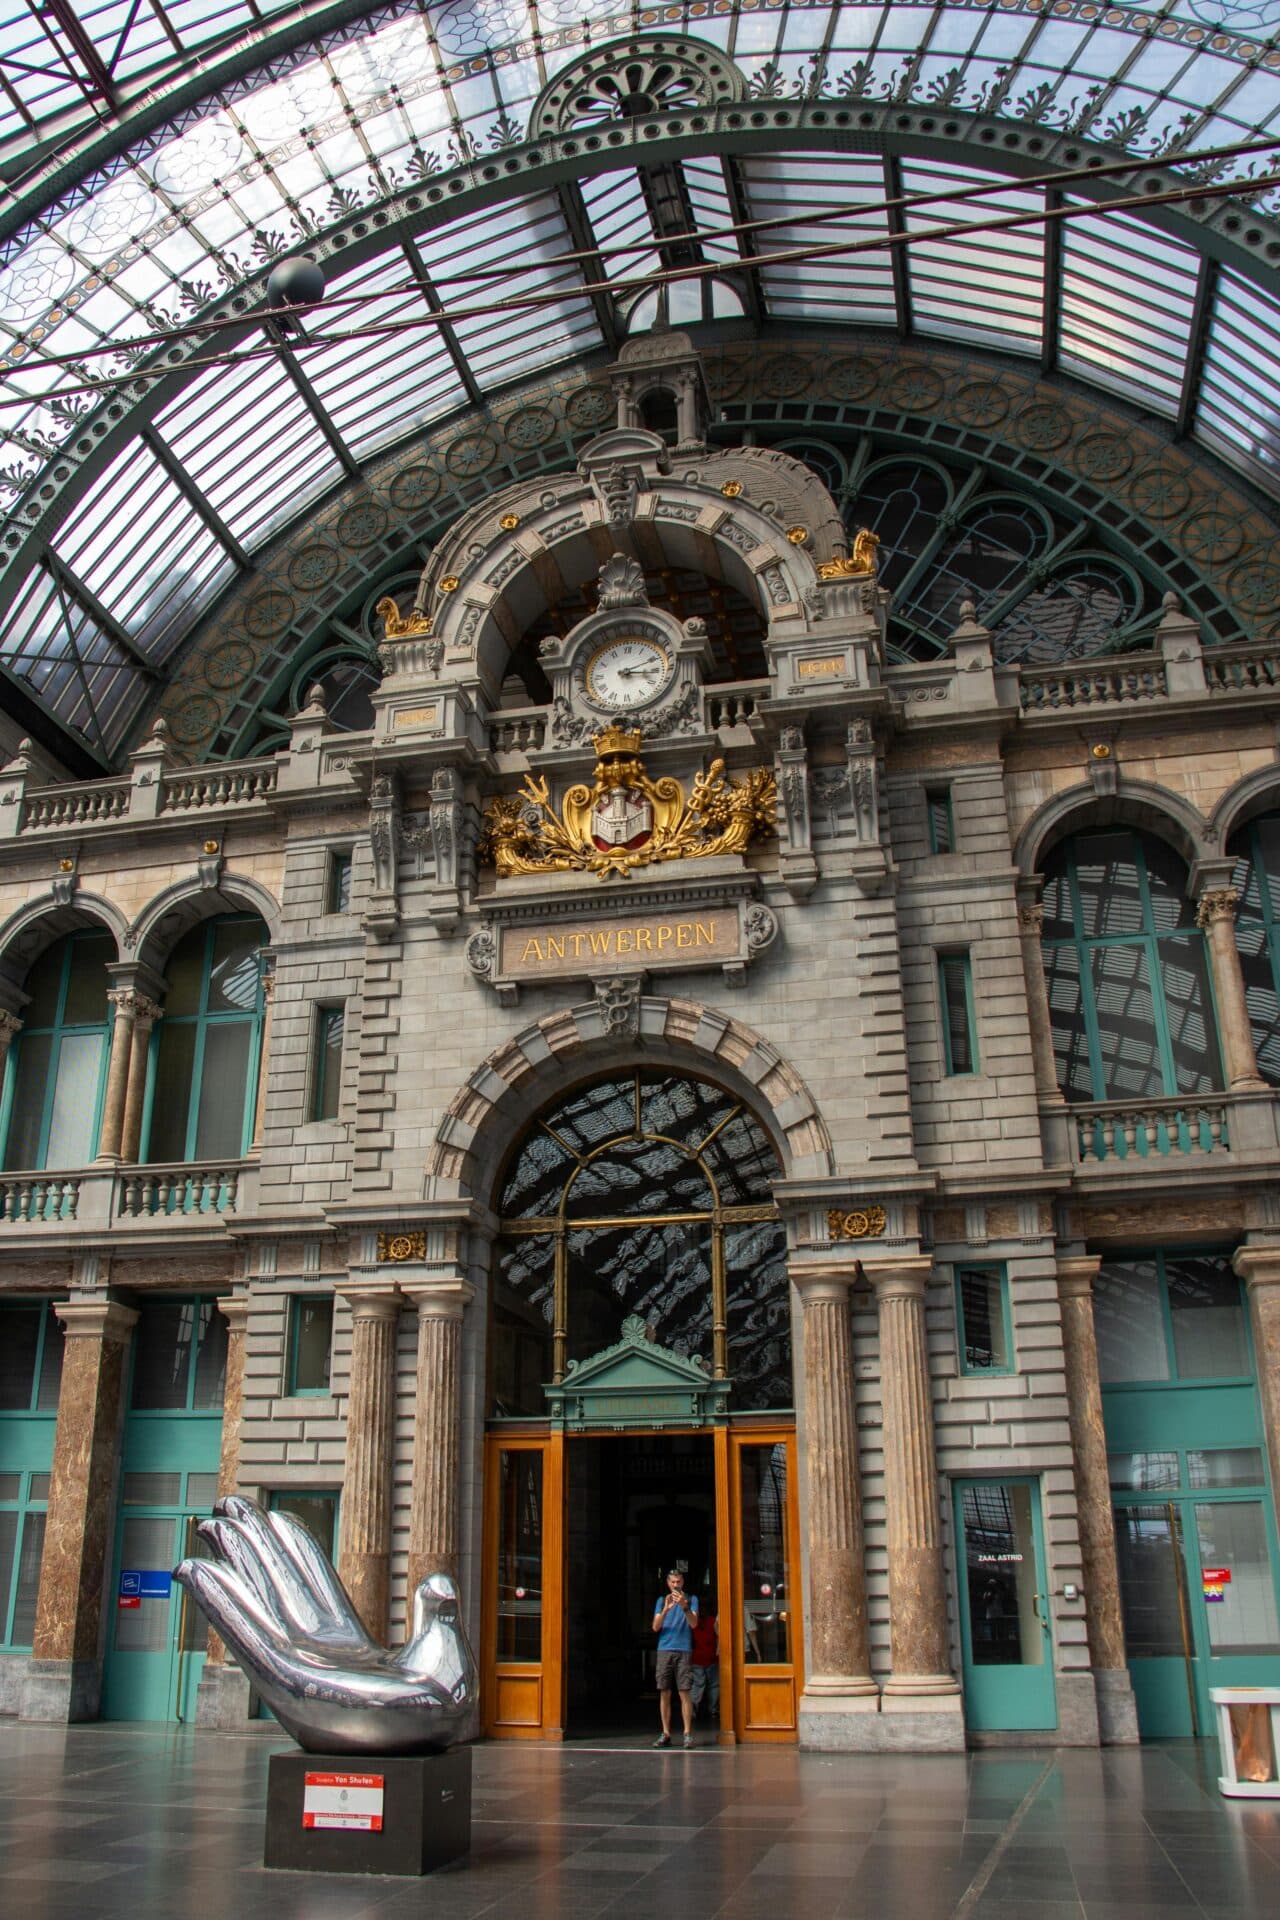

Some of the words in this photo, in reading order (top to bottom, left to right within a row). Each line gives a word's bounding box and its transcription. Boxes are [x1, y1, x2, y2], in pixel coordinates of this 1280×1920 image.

[520, 920, 716, 962] ANTWERPEN
[978, 1554, 997, 1562] ZAAL
[997, 1553, 1023, 1561] ASTRID
[334, 1775, 348, 1783] Yan
